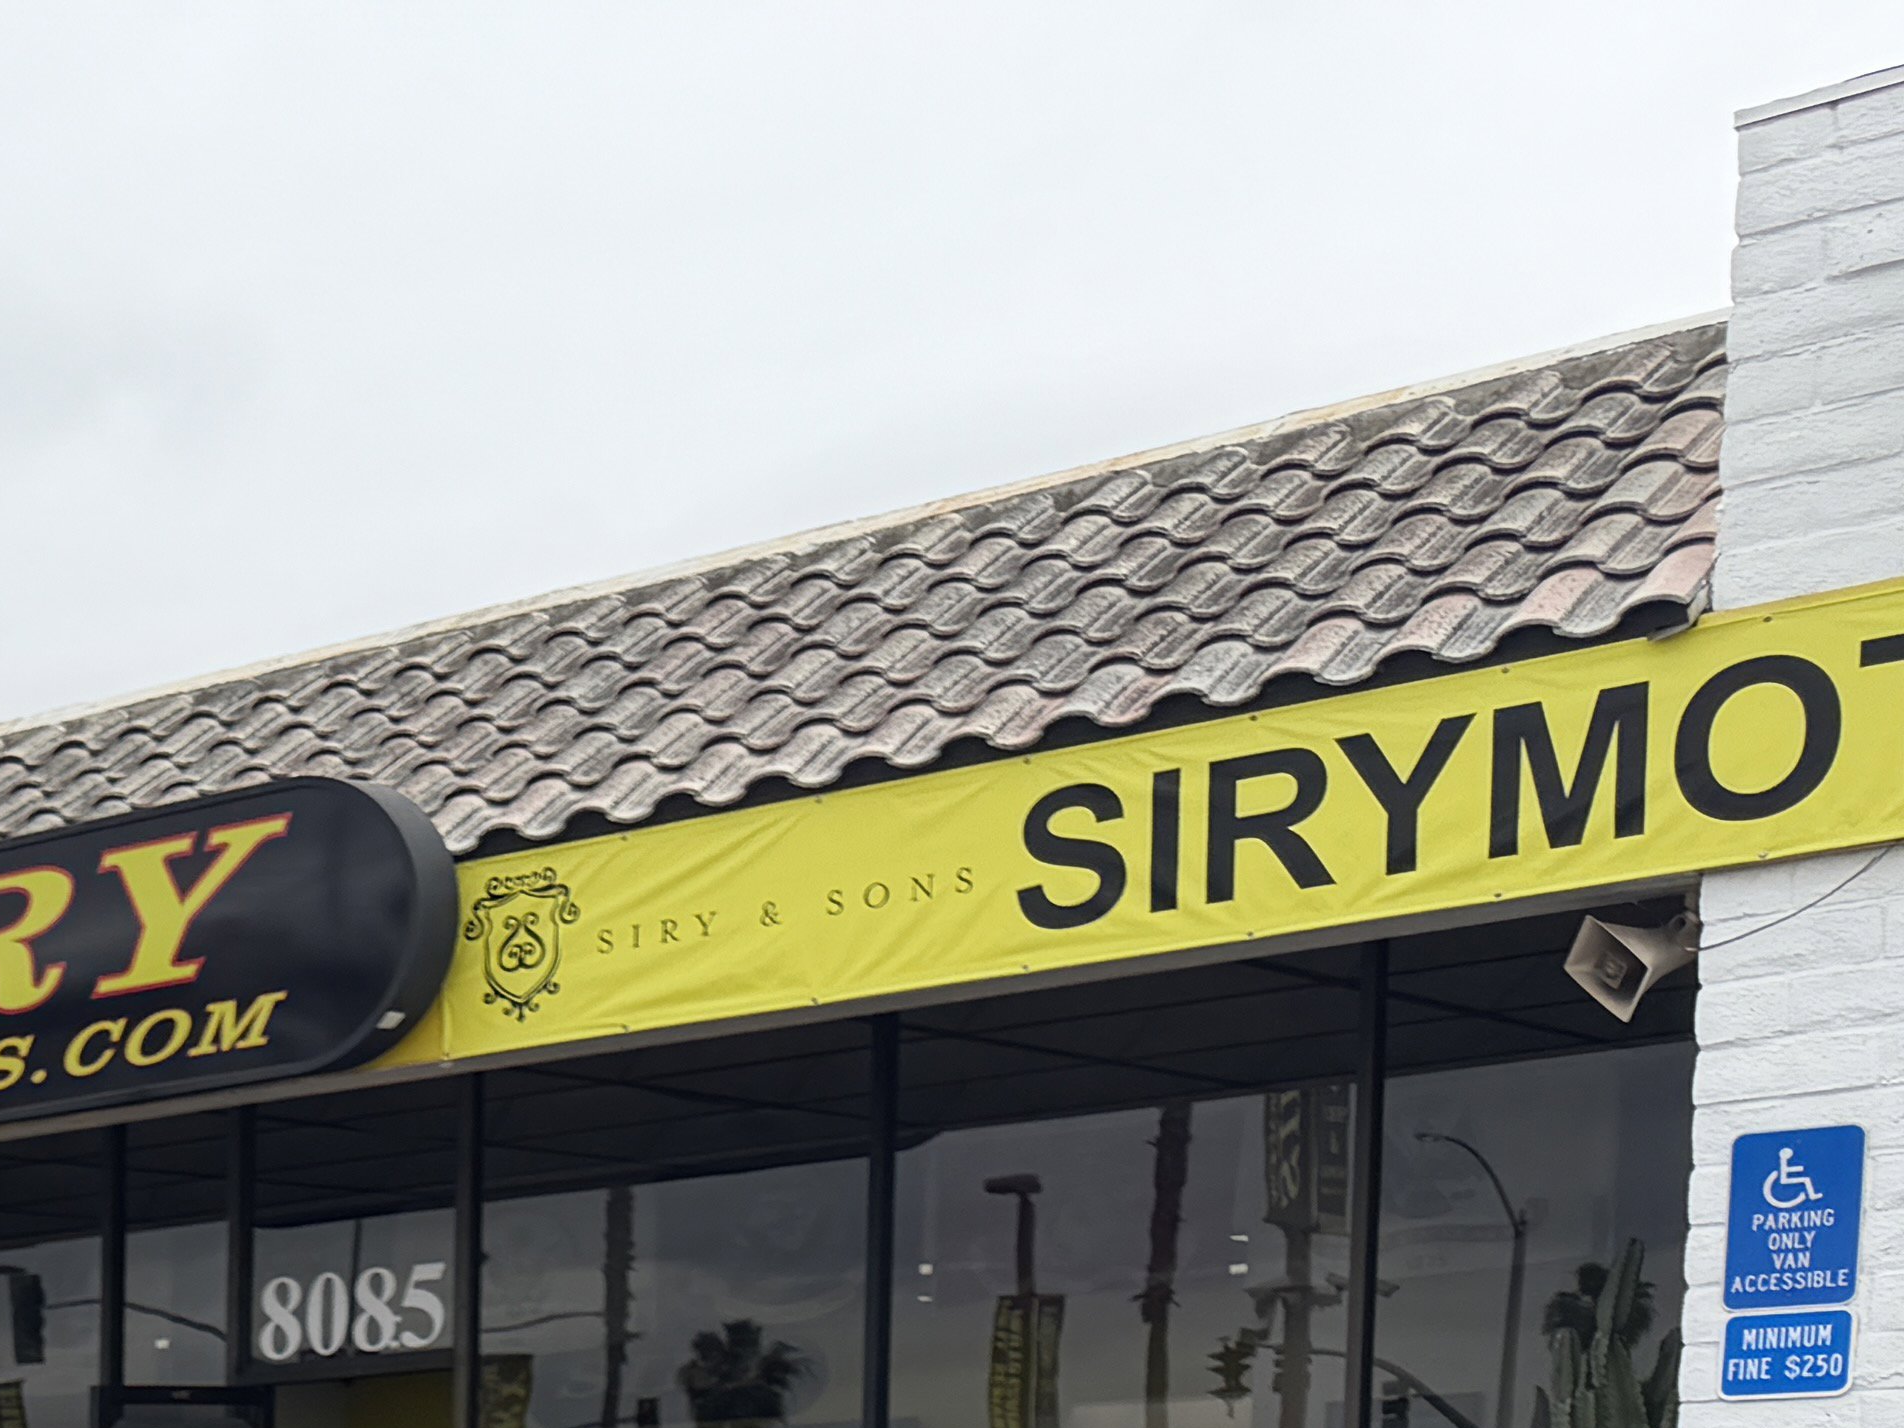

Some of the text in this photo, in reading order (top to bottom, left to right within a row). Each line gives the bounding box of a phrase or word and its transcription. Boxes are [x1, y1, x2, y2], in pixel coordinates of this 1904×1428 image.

[595, 866, 974, 955] SIRY & SONS
[1752, 1208, 1835, 1231] PARKING
[1767, 1231, 1816, 1251] ONLY
[1771, 1252, 1811, 1269] VAN
[1730, 1269, 1850, 1293] ACCESSIBLE
[258, 1261, 447, 1361] 8085
[1742, 1324, 1833, 1350] MINIMUM
[1726, 1354, 1843, 1382] FINE $250
